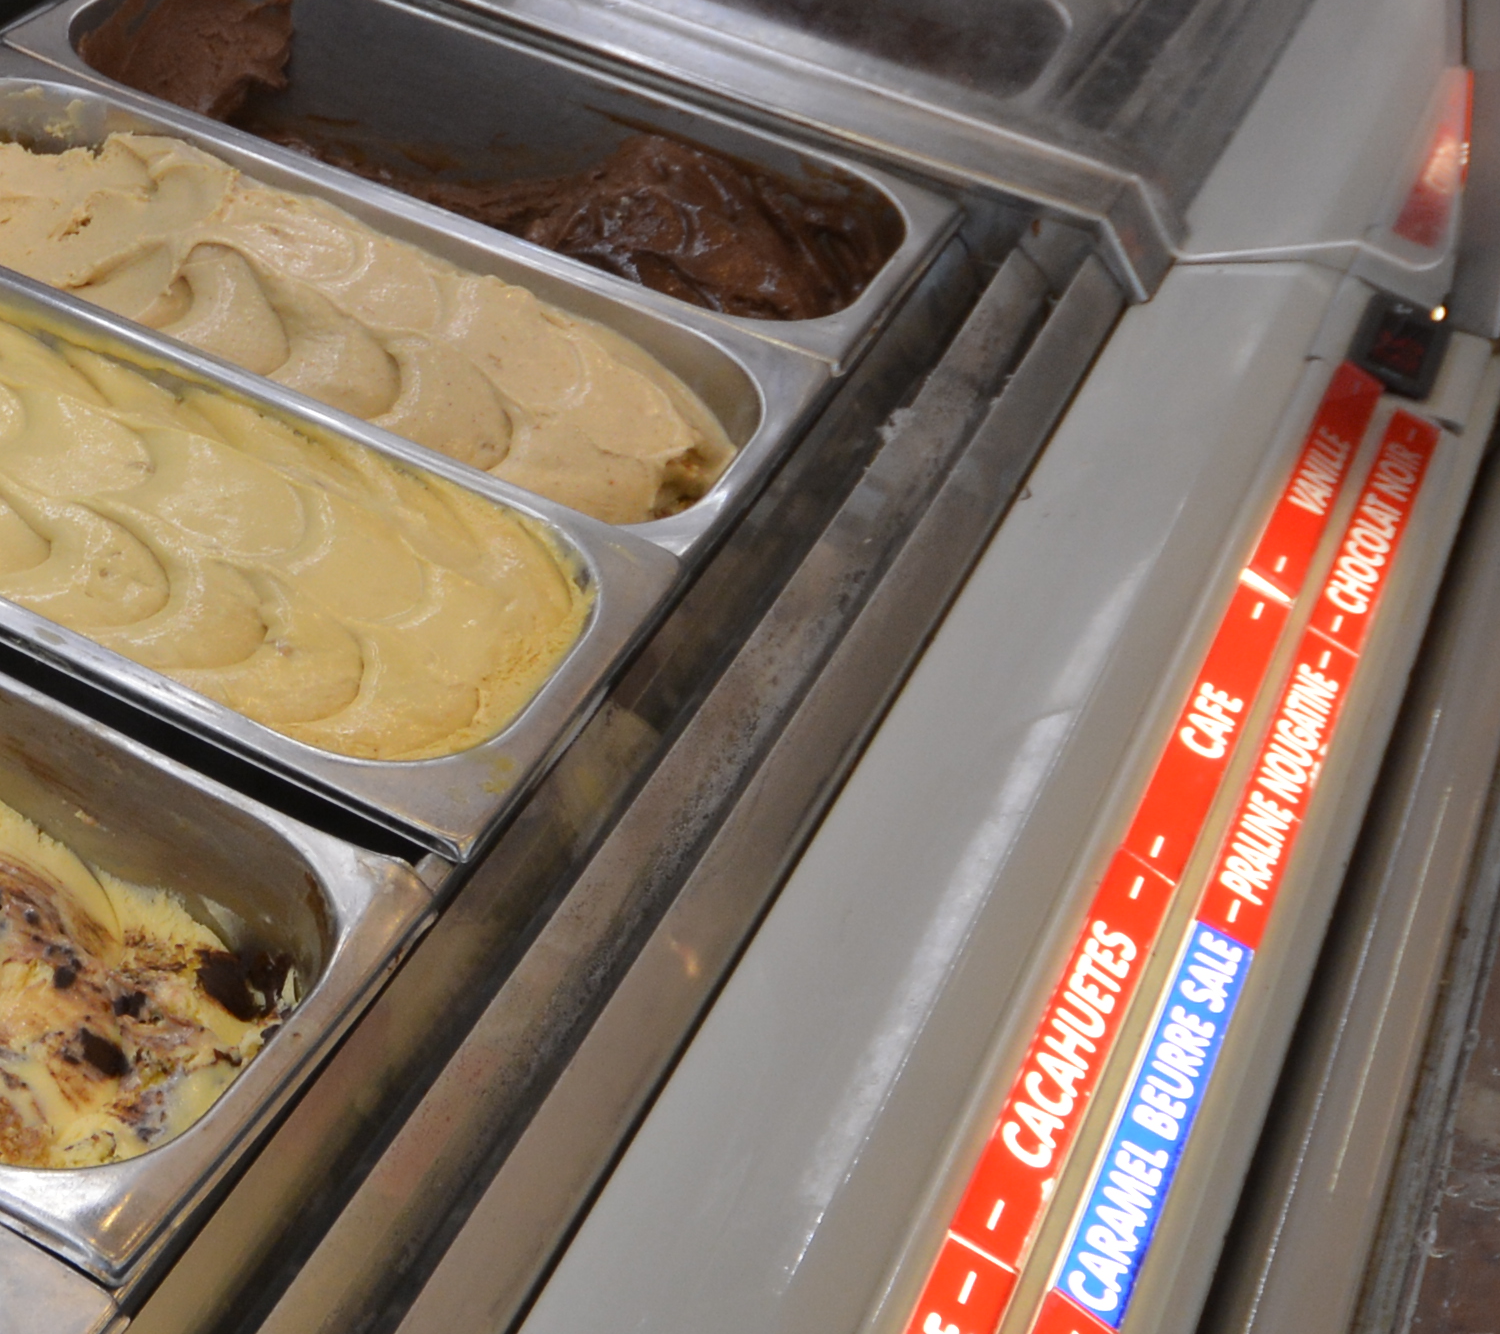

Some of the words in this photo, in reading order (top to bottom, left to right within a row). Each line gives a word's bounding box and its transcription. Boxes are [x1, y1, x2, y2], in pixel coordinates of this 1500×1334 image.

[1287, 426, 1349, 515] VANILLE
[1325, 492, 1402, 614] CHOCOLAT
[1371, 441, 1424, 502] NOIR
[1179, 682, 1244, 758] CAFE
[1220, 790, 1294, 906] PRALINE
[1257, 663, 1339, 804] NOUGATINE
[1001, 920, 1137, 1169] CACAHUETES
[1067, 1140, 1169, 1313] CARAMEL
[1131, 1004, 1215, 1142] BEURRE
[1181, 931, 1244, 1013] SALE
